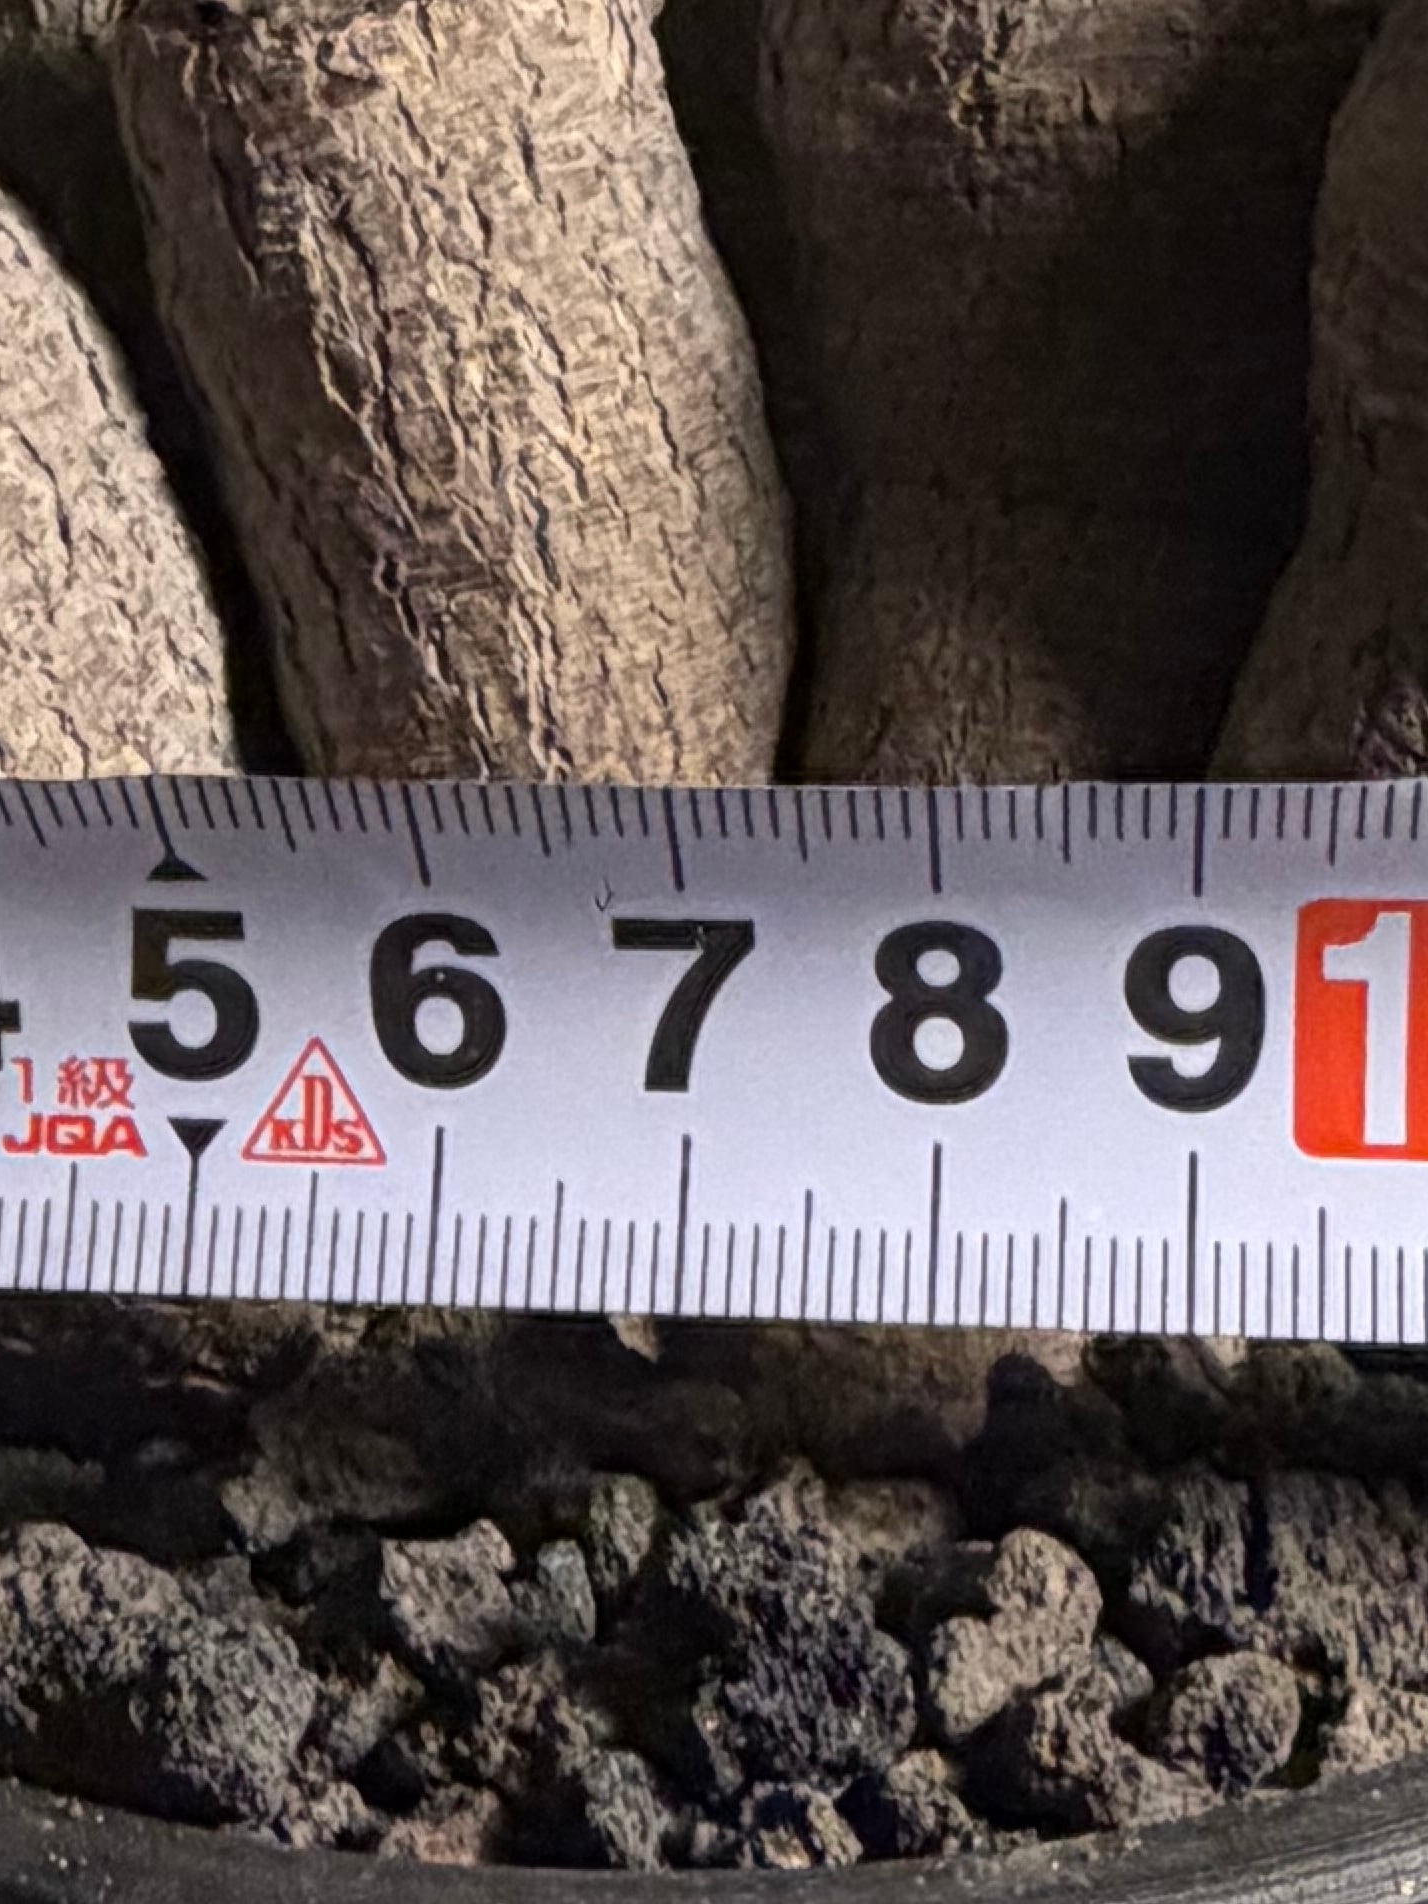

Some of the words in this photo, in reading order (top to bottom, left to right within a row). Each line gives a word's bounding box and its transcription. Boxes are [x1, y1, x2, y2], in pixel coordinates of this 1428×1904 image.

[128, 905, 260, 1082] 5
[369, 911, 507, 1089] 6
[611, 916, 756, 1093] 7
[869, 920, 1009, 1105] 8
[1123, 924, 1266, 1112] 9
[10, 1056, 135, 1110] 1級
[268, 1074, 367, 1154] KDS
[0, 1112, 148, 1159] JQA
